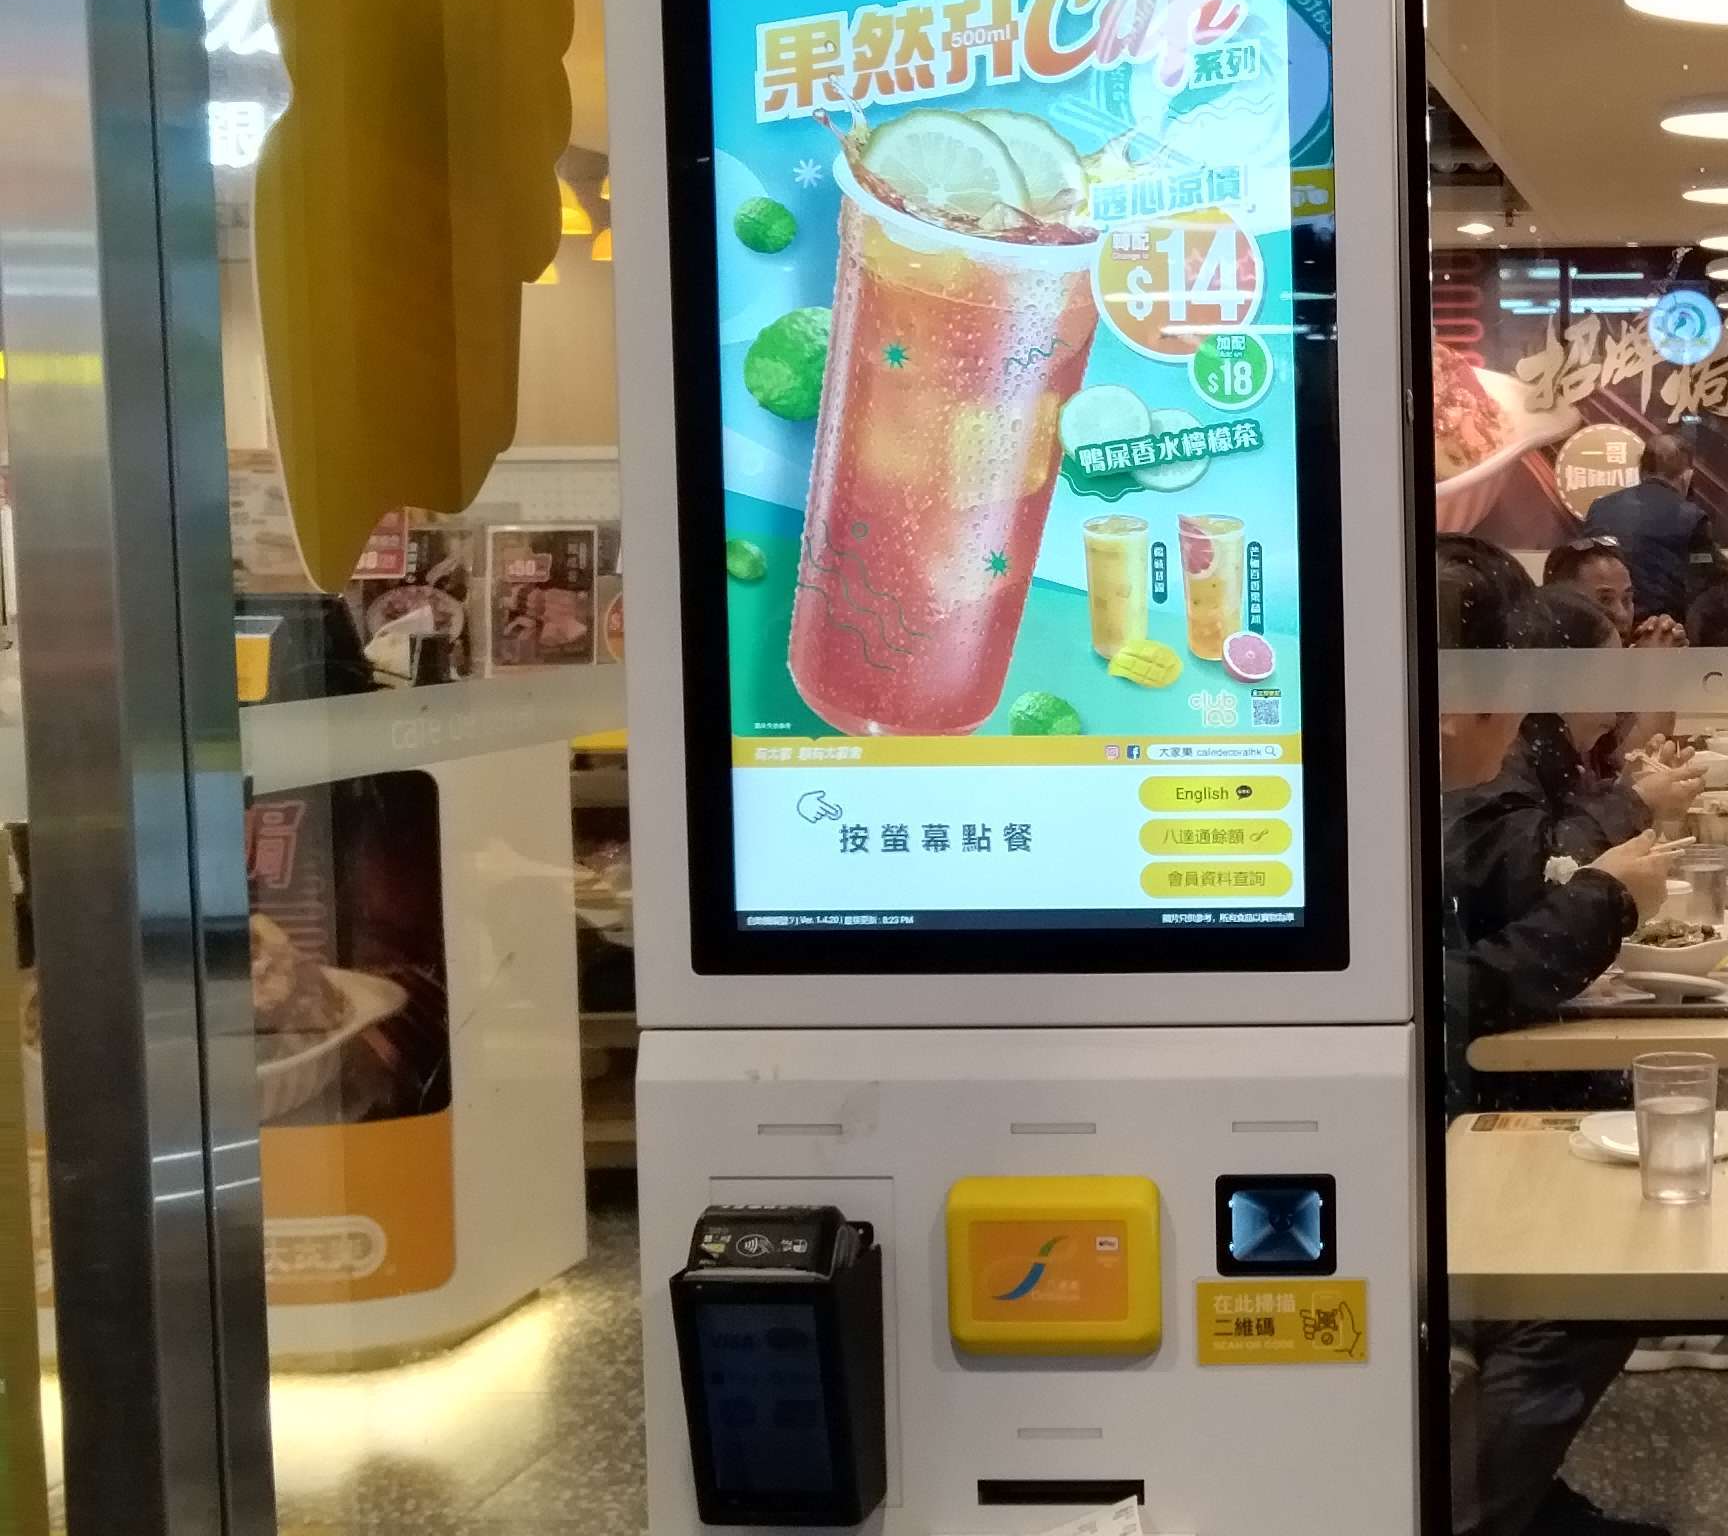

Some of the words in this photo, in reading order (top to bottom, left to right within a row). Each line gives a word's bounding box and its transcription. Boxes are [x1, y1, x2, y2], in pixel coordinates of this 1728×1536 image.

[950, 26, 1012, 48] 500ml
[1126, 228, 1245, 322] $14
[1208, 360, 1253, 396] $18
[1078, 422, 1260, 473] 鴨屎香水檸檬茶
[1176, 787, 1229, 803] English
[838, 822, 1034, 854] 按螢幕點餐
[1163, 829, 1244, 845] 八達通餘額
[1168, 871, 1266, 887] 會員資料查詢
[1212, 1293, 1296, 1314] 在此掃描
[1213, 1317, 1276, 1338] 二維碼
